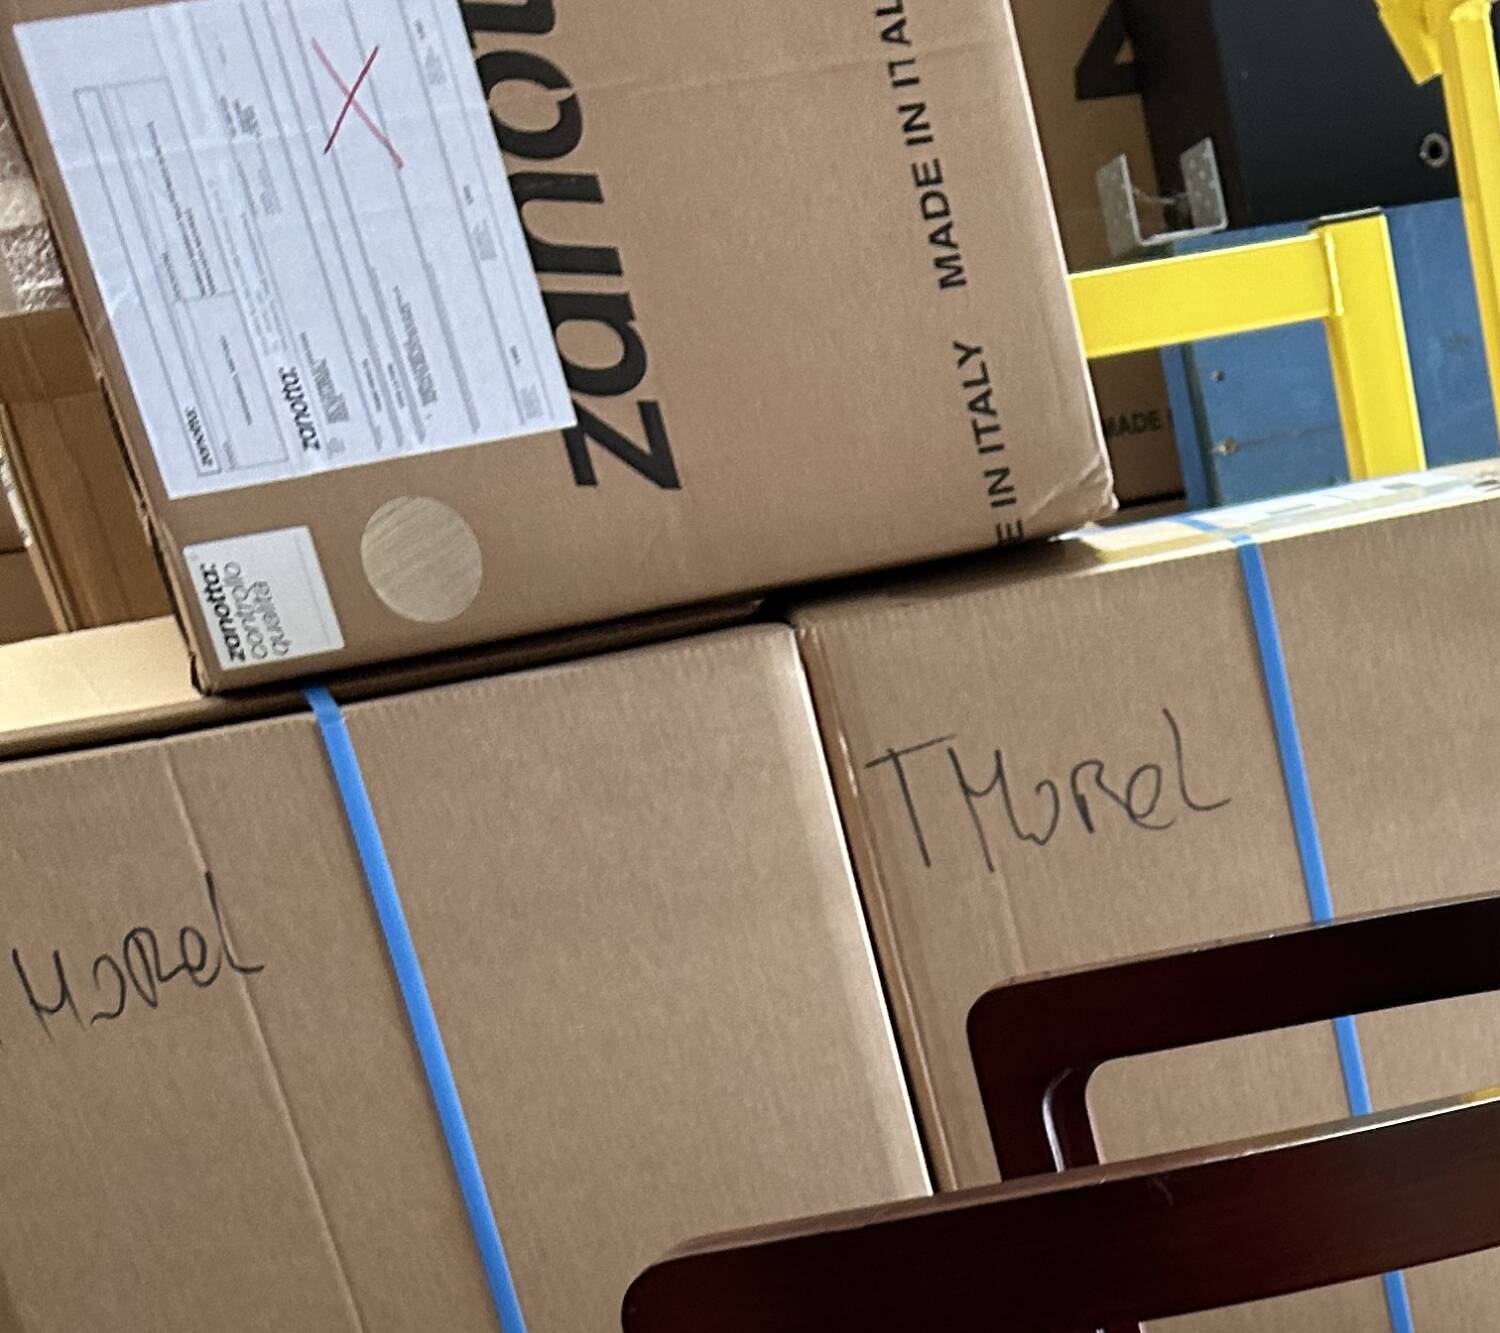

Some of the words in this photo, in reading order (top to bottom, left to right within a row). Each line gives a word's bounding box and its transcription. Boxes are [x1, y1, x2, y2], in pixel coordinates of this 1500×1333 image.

[897, 102, 934, 146] IN
[910, 158, 968, 289] MADE
[953, 340, 1005, 455] ITALY
[983, 466, 1018, 509] IN
[223, 561, 269, 660] controllo
